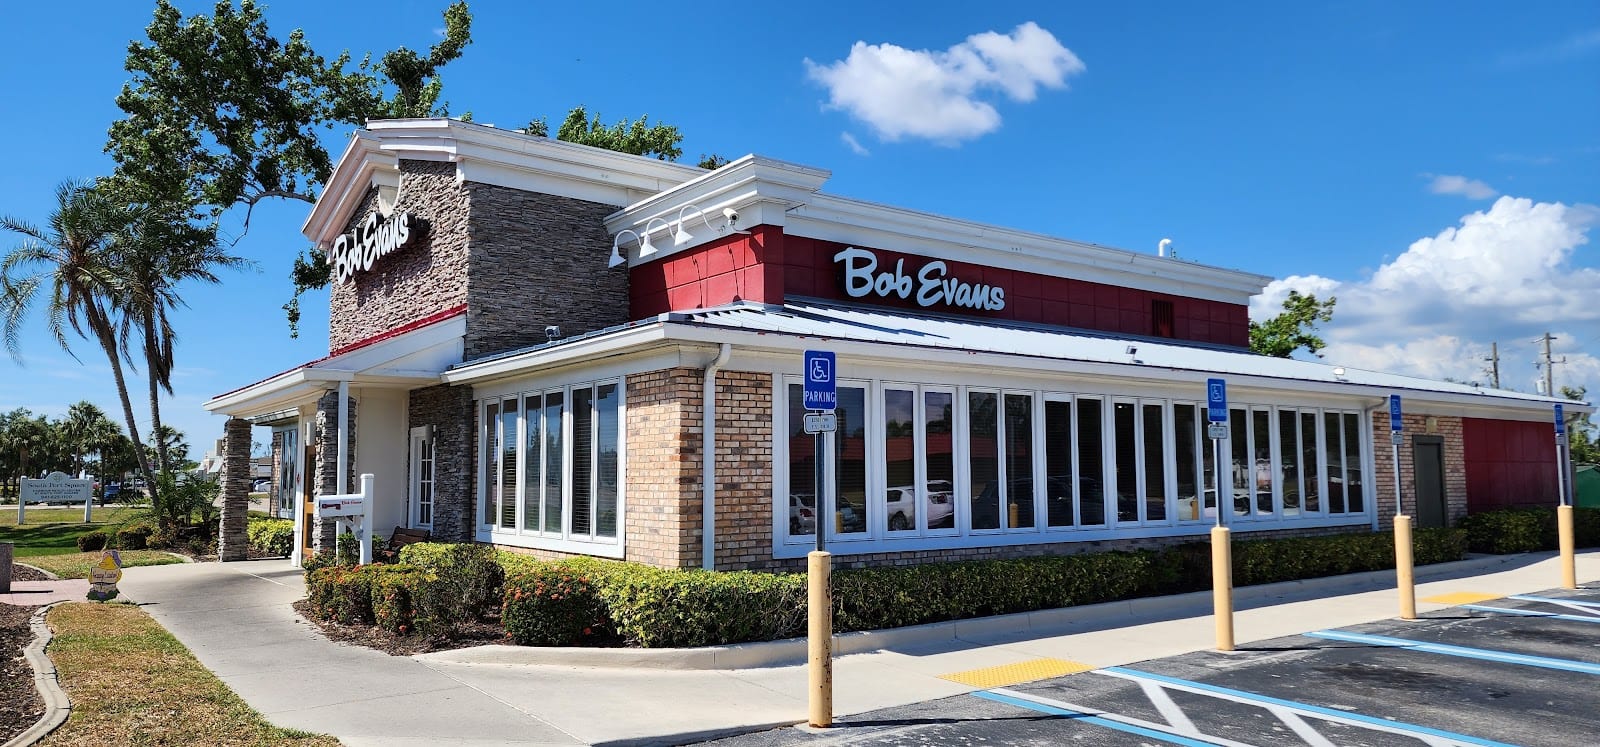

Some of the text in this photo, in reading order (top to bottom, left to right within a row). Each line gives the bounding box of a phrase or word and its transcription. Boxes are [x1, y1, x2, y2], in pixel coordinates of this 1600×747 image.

[333, 212, 409, 285] Bob Evans
[834, 247, 1006, 311] Bob Evans
[805, 391, 836, 403] PARKING
